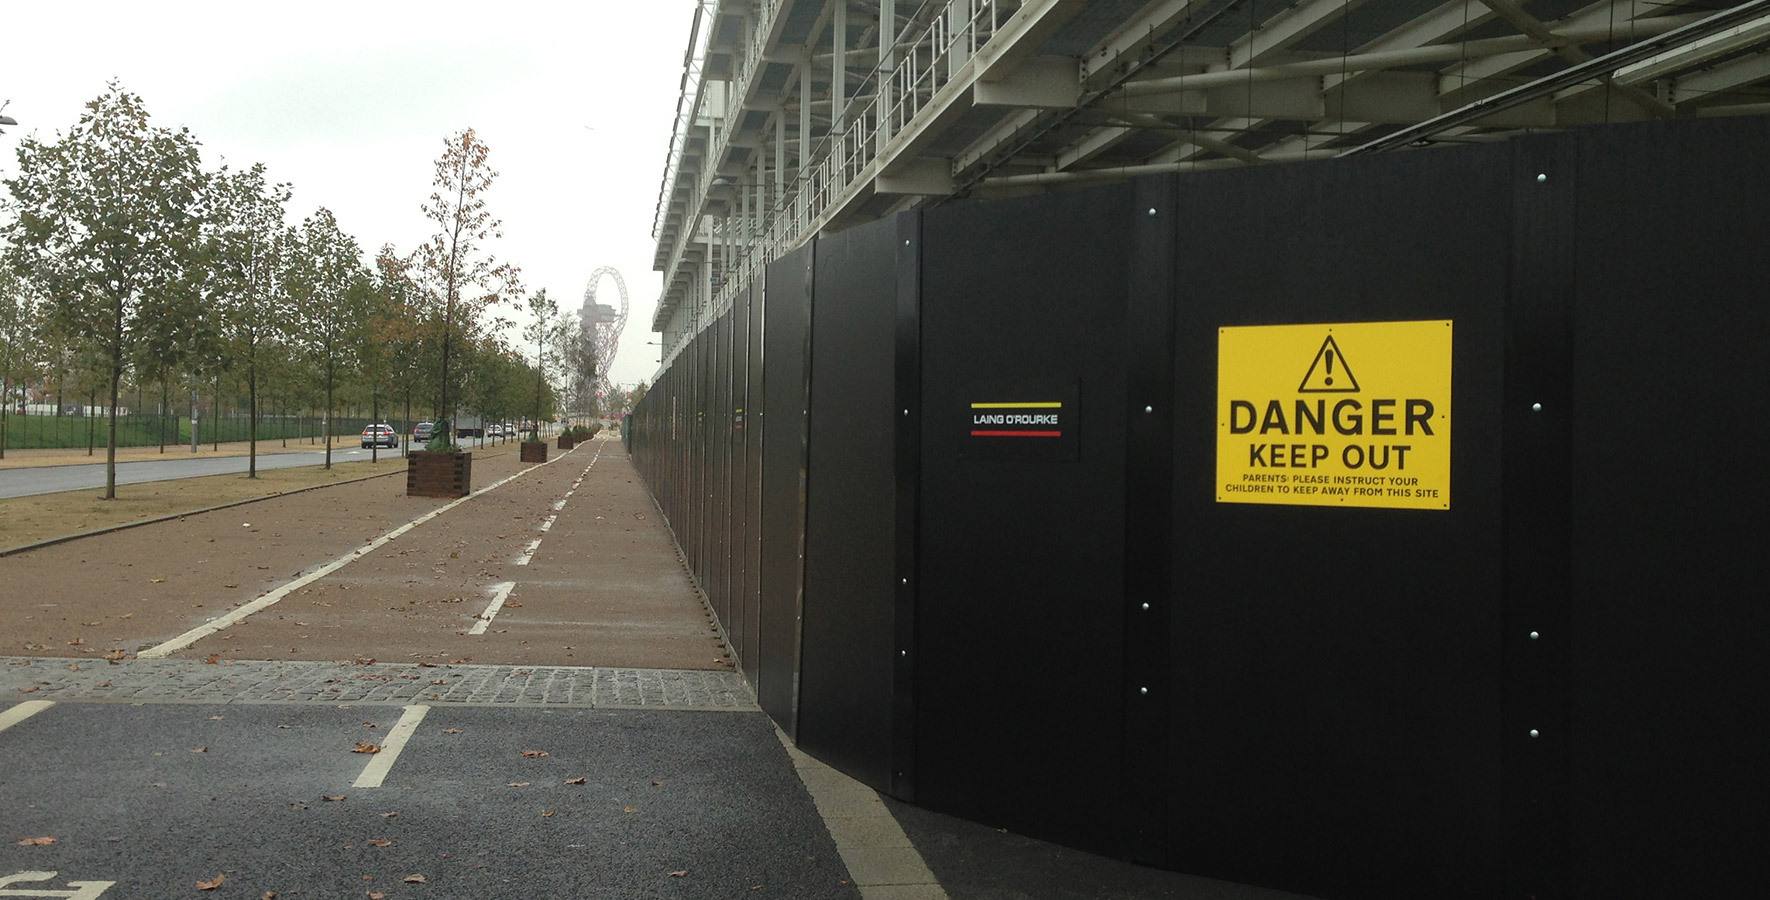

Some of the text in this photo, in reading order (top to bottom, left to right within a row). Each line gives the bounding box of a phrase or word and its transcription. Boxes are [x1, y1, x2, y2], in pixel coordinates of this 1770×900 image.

[974, 415, 1058, 424] LAING O'ROURKE
[1231, 399, 1435, 436] DANGER
[1250, 444, 1411, 470] KEEP OUT
[1293, 475, 1329, 483] PLEASE
[1334, 476, 1384, 485] INSTRUCT
[1388, 478, 1418, 486] YOUR
[1226, 484, 1439, 498] CHILDREN TO KEEP AWAY FROM THIS SITE
